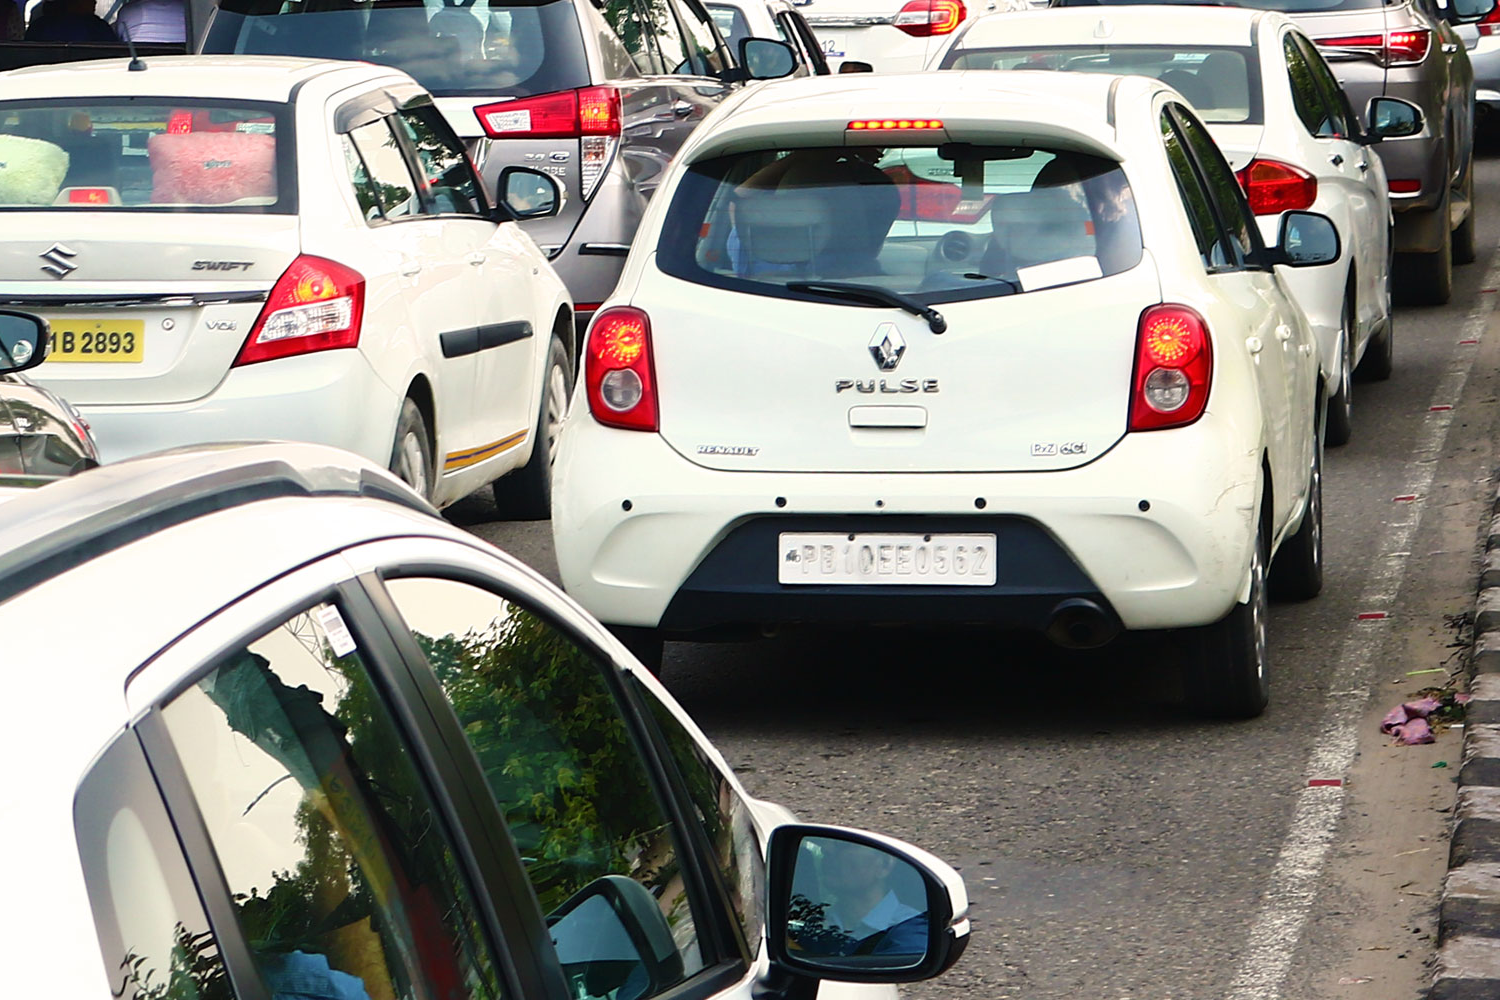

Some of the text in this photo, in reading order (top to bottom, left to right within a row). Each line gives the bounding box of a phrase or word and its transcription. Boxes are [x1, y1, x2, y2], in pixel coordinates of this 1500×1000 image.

[191, 260, 254, 272] SWIFT
[80, 331, 135, 353] 2893
[835, 378, 940, 394] PULSE
[697, 445, 760, 456] RENAULT
